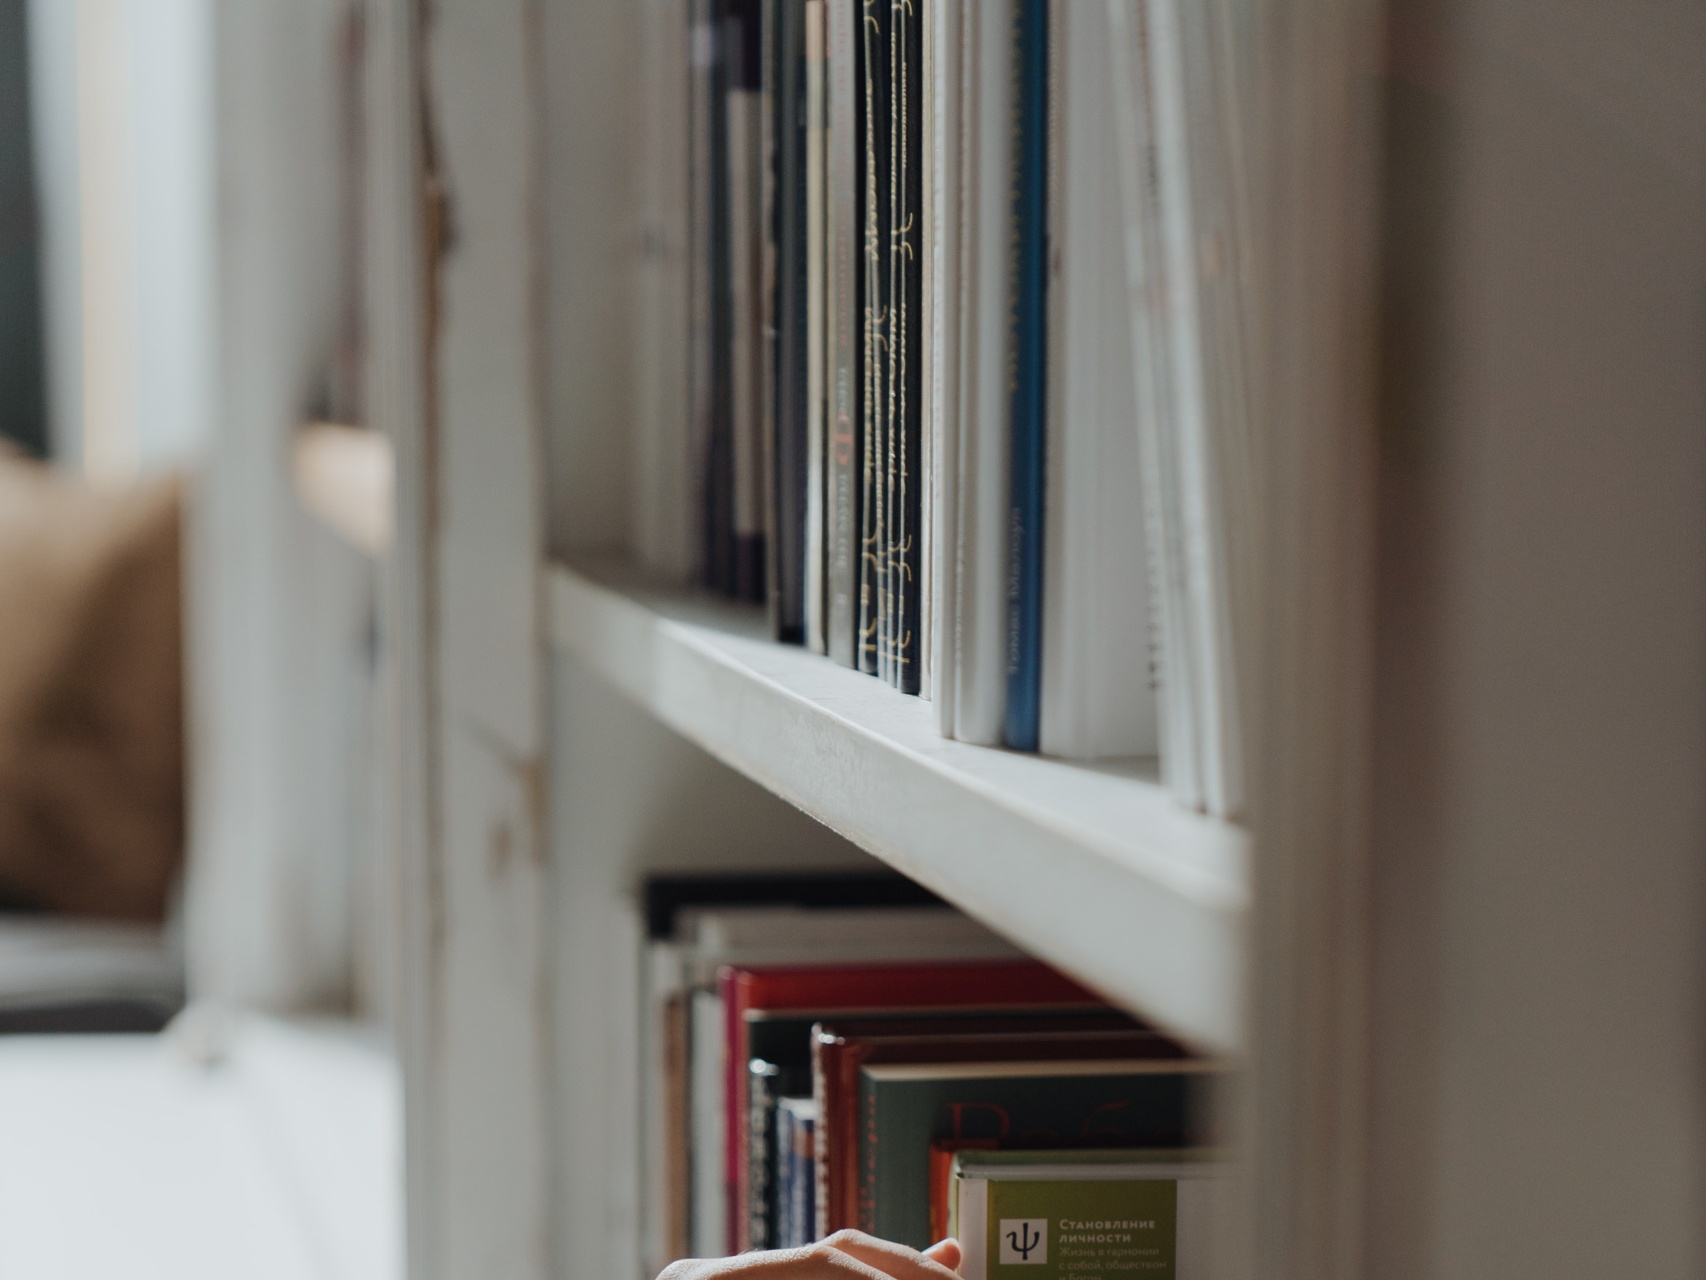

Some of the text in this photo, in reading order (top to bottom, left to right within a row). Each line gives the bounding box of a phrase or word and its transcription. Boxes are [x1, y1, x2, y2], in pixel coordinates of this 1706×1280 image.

[1058, 1218, 1156, 1230] СТАНОВЛЕНИЕ
[1059, 1233, 1132, 1243] ЛИЧНОСТИ
[1059, 1247, 1160, 1258] Жизнь в гармонии
[1058, 1262, 1065, 1270] с
[1105, 1259, 1167, 1271] обществом
